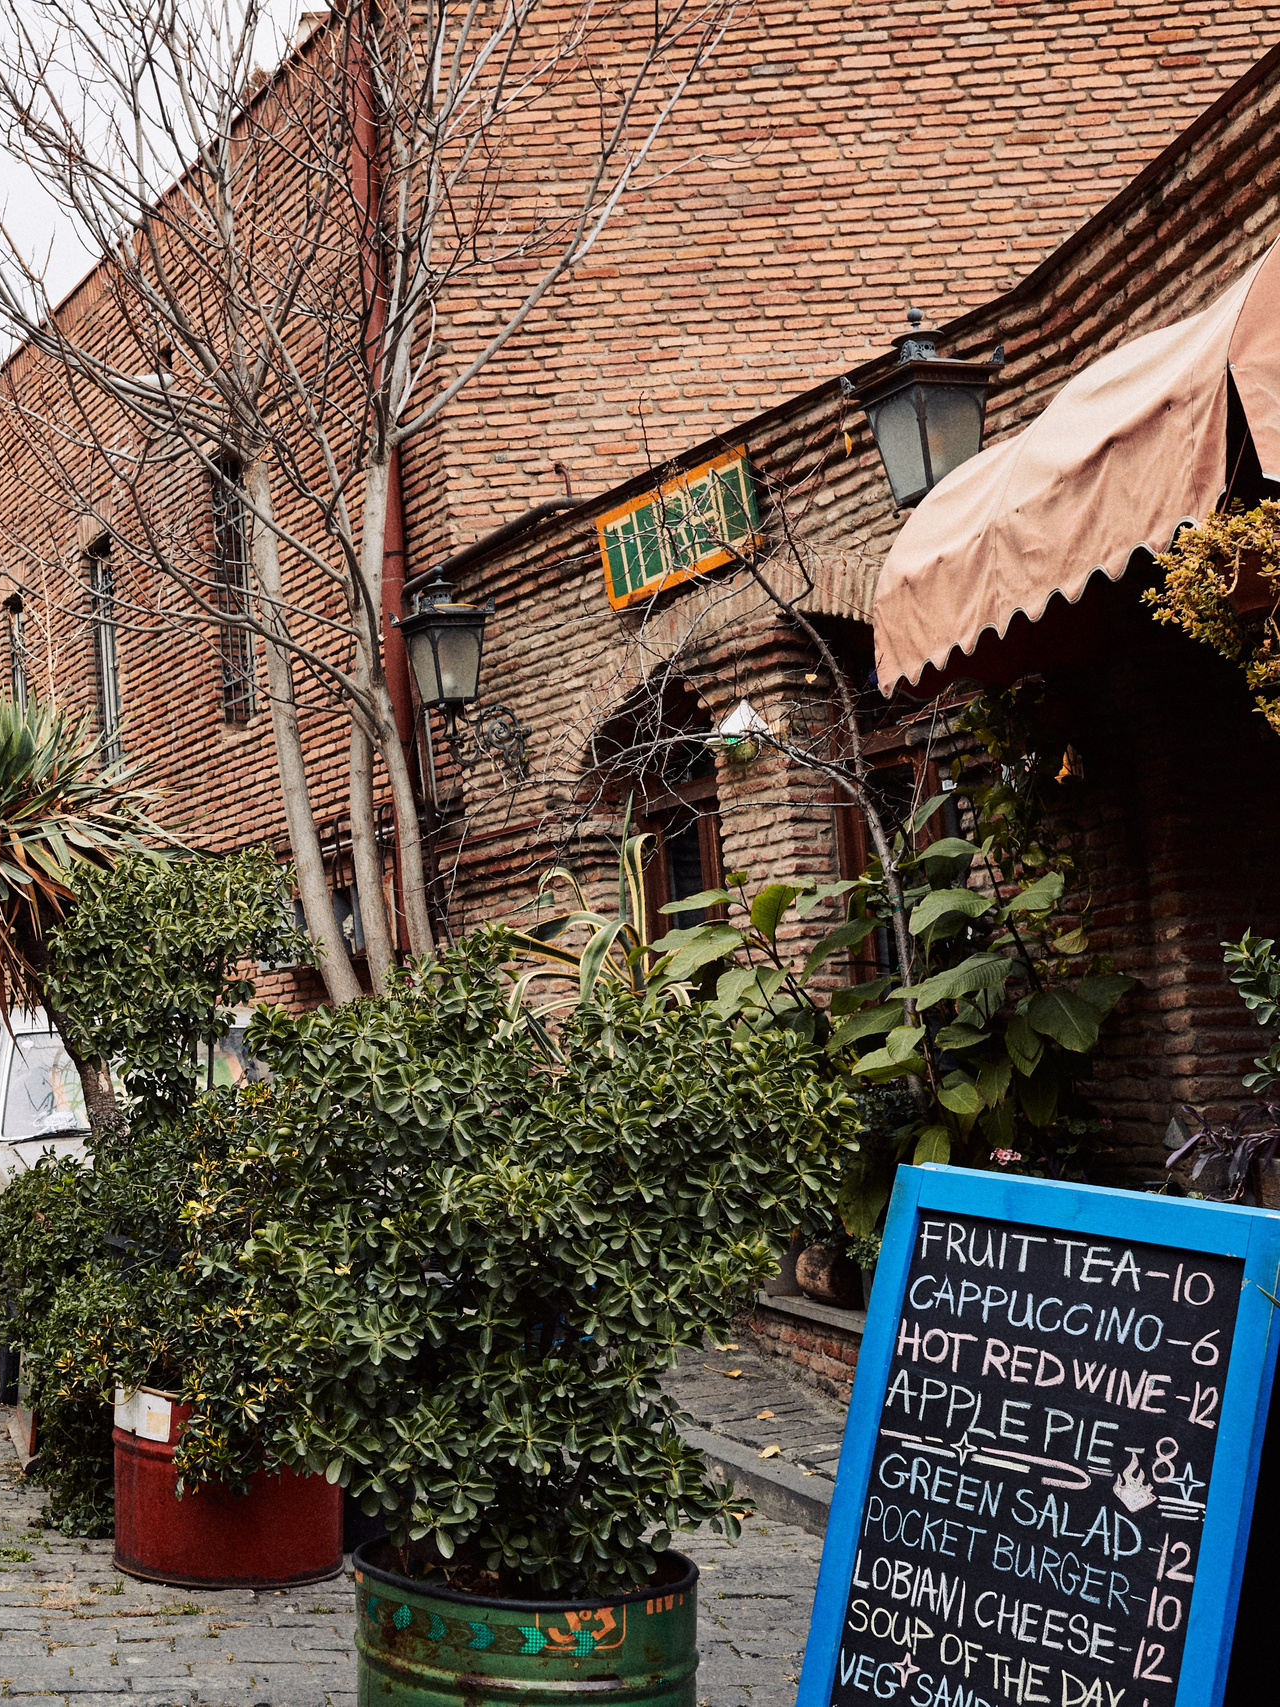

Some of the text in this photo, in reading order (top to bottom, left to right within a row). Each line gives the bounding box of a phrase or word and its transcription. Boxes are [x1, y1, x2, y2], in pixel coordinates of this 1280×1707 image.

[920, 1221, 1047, 1273] FRUIT
[896, 1318, 978, 1373] HOT
[981, 1337, 1065, 1387] RED
[885, 1368, 1033, 1442] APPLE
[864, 1496, 987, 1561] POCKET
[878, 1452, 1004, 1518] GREEN
[1011, 1488, 1142, 1561] SALAD
[853, 1549, 966, 1628] LOBIANI
[840, 1648, 901, 1698] VEG
[848, 1598, 1126, 1707] SOUP OF THE DAY
